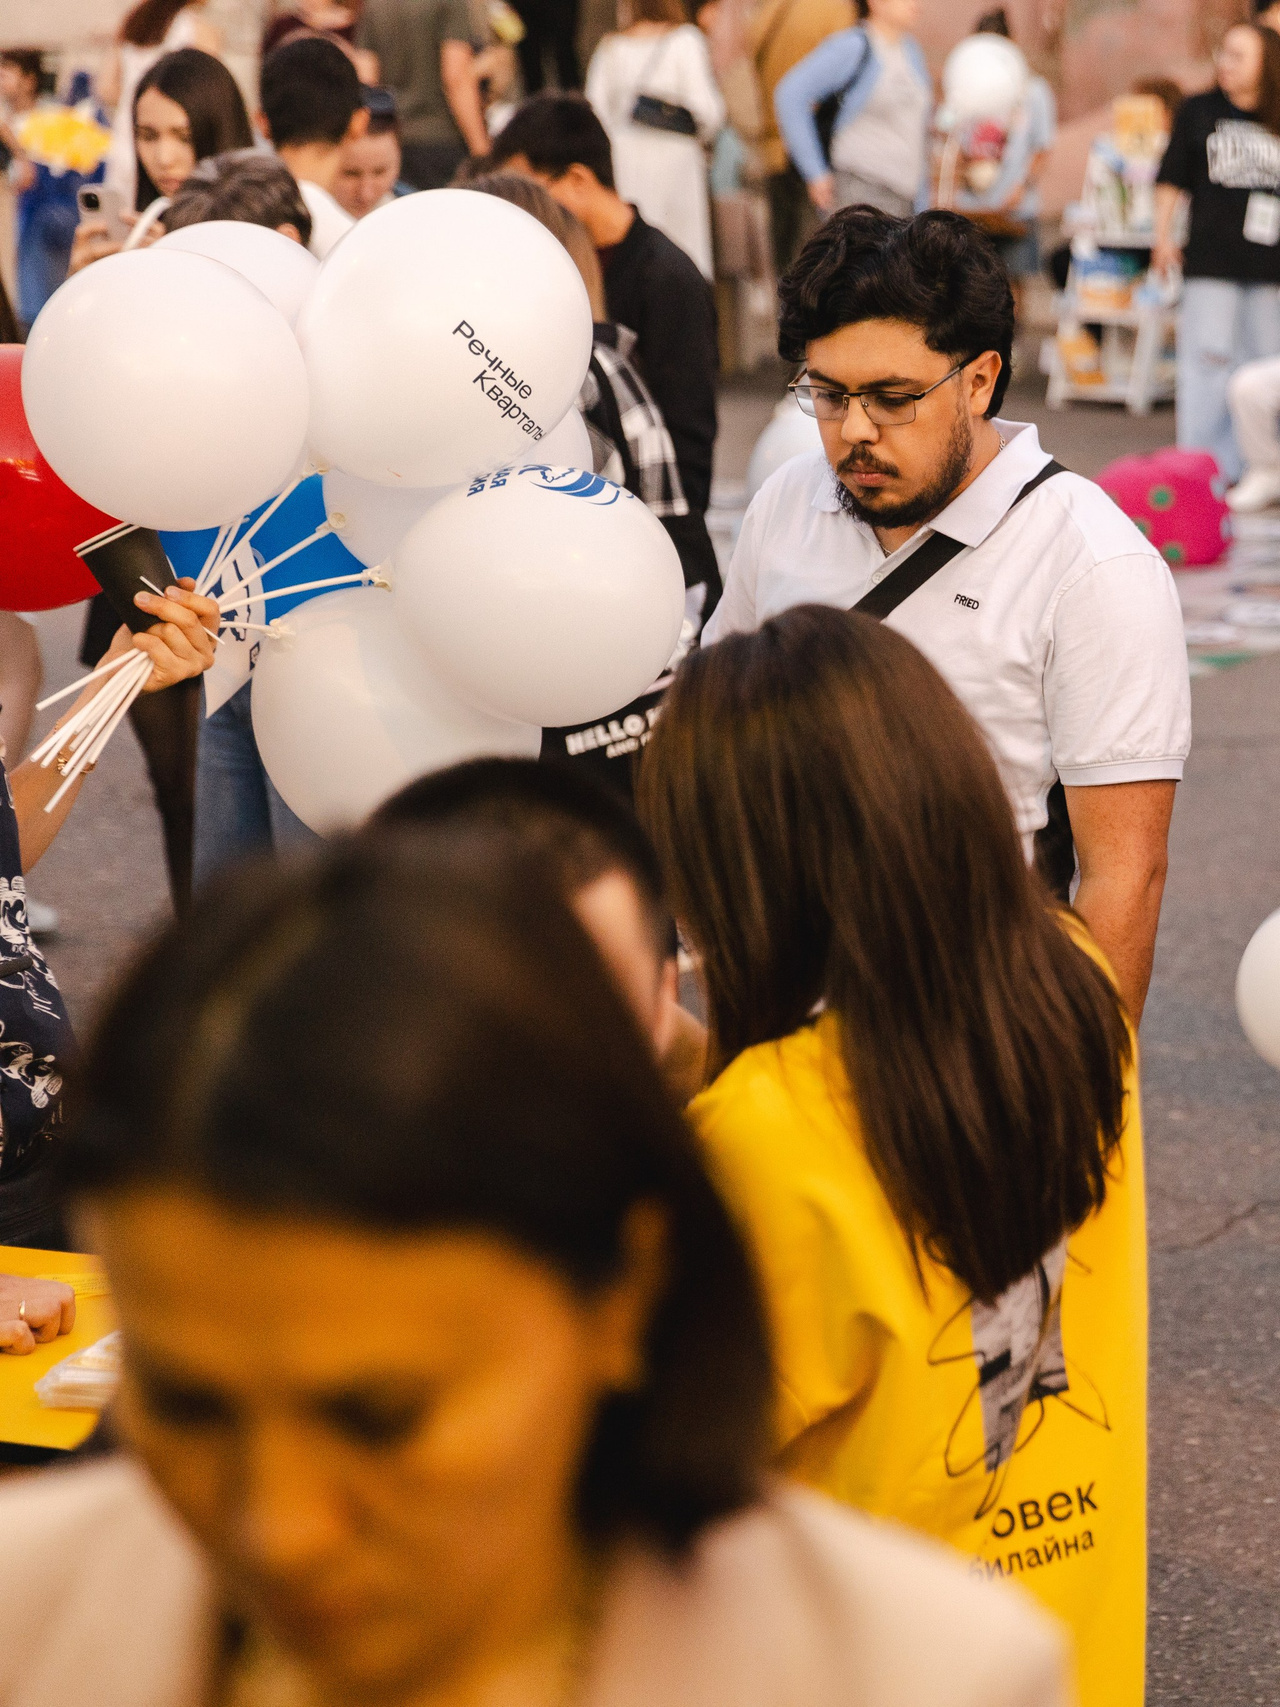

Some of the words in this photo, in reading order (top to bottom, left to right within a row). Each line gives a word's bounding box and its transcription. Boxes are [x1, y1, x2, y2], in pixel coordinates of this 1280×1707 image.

[452, 319, 533, 400] Речные
[953, 593, 980, 611] FRIED
[565, 714, 646, 756] HELLO
